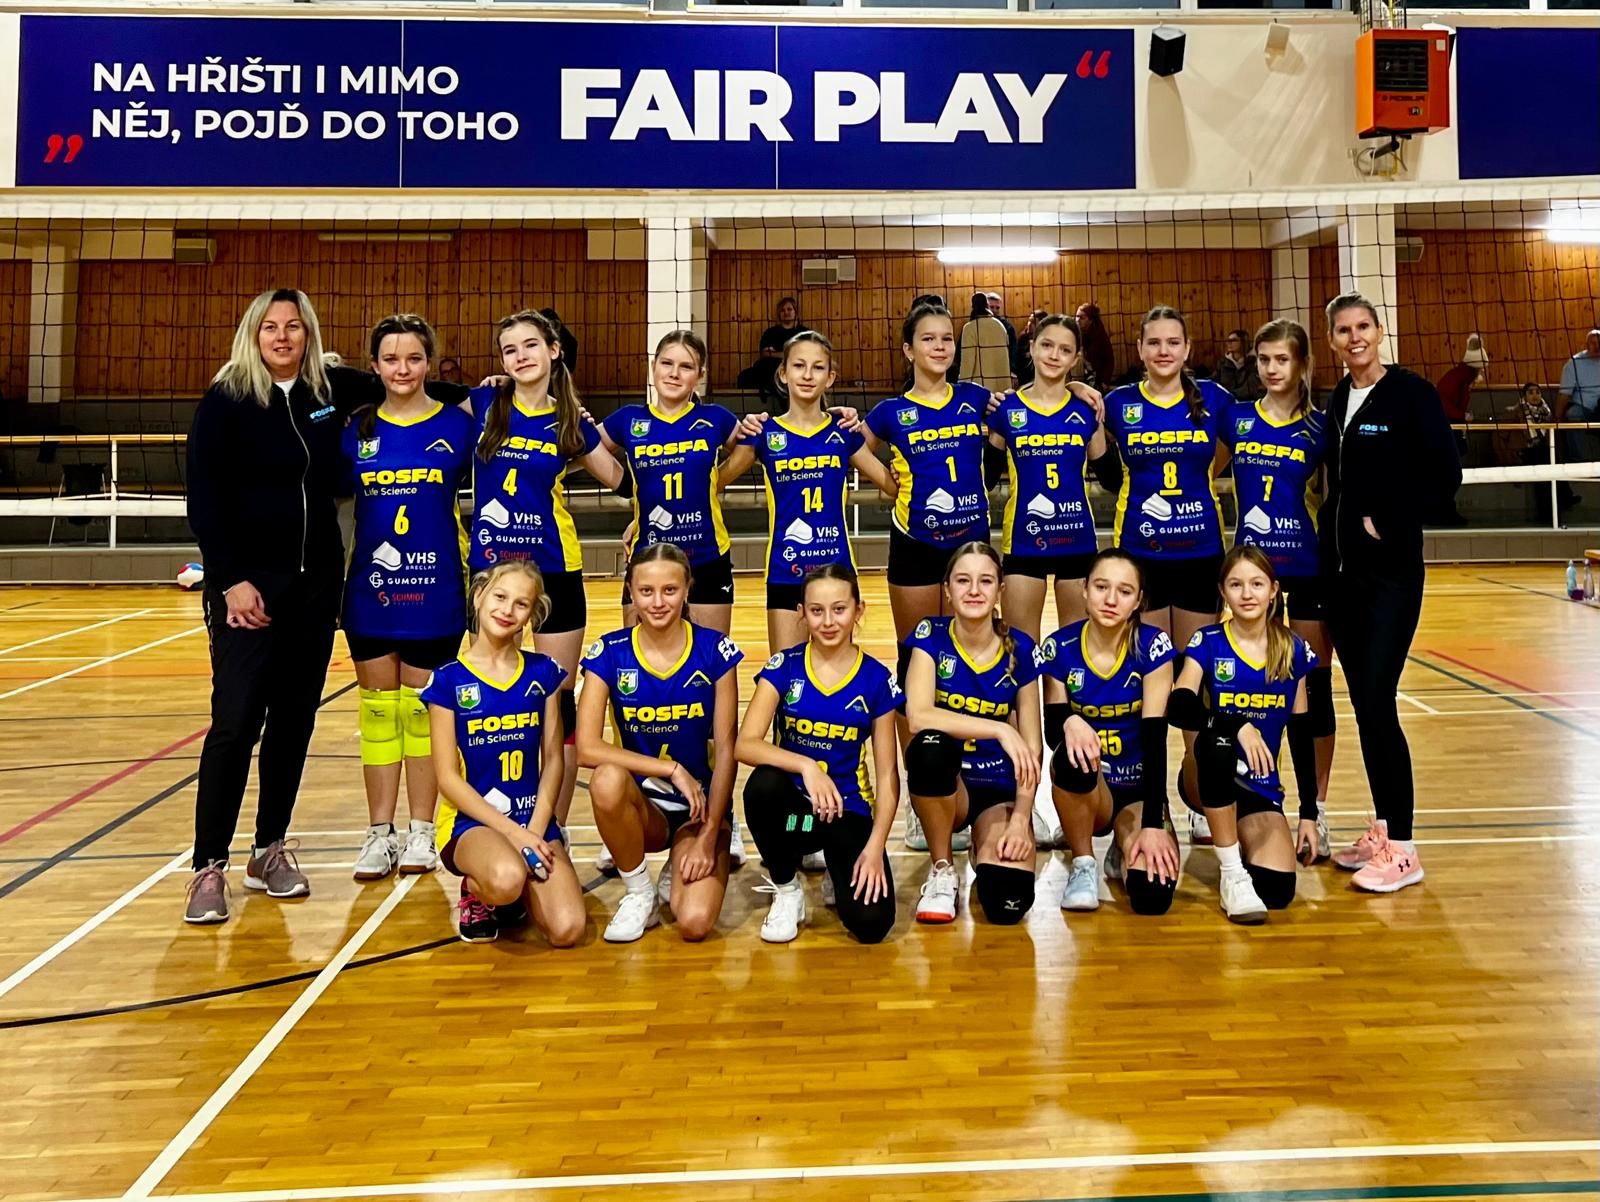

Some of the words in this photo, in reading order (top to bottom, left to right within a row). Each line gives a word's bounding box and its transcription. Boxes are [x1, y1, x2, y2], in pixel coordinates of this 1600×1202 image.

[92, 62, 155, 93] NA
[167, 56, 301, 94] HŘIŠTI
[316, 64, 325, 94] I
[340, 64, 460, 95] MIMO
[560, 67, 794, 142] FAIR
[813, 71, 1069, 144] PLAY
[91, 101, 181, 145] NĚJ,
[194, 102, 307, 141] POJĎ
[322, 110, 386, 141] DO
[397, 110, 520, 141] TOHO
[908, 423, 980, 446] FOSFA
[1015, 434, 1084, 449] FOSFA
[1127, 430, 1210, 447] FOSFA
[496, 449, 530, 461] cience
[634, 439, 709, 459] FOSFA
[910, 445, 925, 455] Life
[927, 441, 959, 452] Science
[1016, 449, 1030, 458] Life
[1031, 448, 1063, 457] Science
[1128, 447, 1143, 456] Life
[1145, 446, 1184, 455] Science
[1235, 441, 1306, 464] FOSFA
[635, 458, 647, 469] Life
[649, 456, 685, 467] Science
[774, 455, 841, 473] FOSFA
[945, 456, 957, 482] 1
[1247, 456, 1281, 468] Science
[361, 468, 443, 487] FOSFA
[502, 468, 518, 497] 4
[776, 473, 790, 482] Life
[792, 471, 823, 481] Science
[1045, 463, 1059, 490] 5
[1163, 461, 1177, 490] 8
[364, 488, 378, 497] Life
[380, 486, 417, 496] Science
[662, 472, 683, 501] 11
[1262, 474, 1274, 502] 7
[801, 486, 823, 513] 14
[957, 494, 978, 506] VHS
[1058, 501, 1082, 513] VHS
[1176, 501, 1204, 514] VHS
[394, 505, 409, 535] 6
[514, 512, 542, 525] VHS
[677, 511, 702, 524] VHS
[943, 515, 981, 527] GUMOTEX
[1275, 517, 1301, 530] VHS
[816, 526, 840, 538] VHS
[1044, 523, 1084, 532] GUMOTEX
[1159, 524, 1206, 535] GUMOTEX
[496, 534, 543, 545] GUMOTEX
[661, 533, 703, 542] GUMOTEX
[1259, 540, 1302, 548] GUMOTEX
[406, 552, 436, 564] VHS
[800, 548, 840, 558] GUMOTEX
[387, 577, 436, 586] GUMOTEX
[935, 688, 1010, 717] FOSFA
[1219, 691, 1287, 709] FOSFA
[623, 702, 705, 722] FOSFA
[1070, 699, 1143, 719] FOSFA
[467, 711, 540, 735] FOSFA
[640, 722, 679, 733] Science
[784, 715, 859, 742] FOSFA
[468, 734, 485, 747] Life
[487, 732, 525, 745] Science
[797, 736, 833, 751] Science
[1097, 729, 1122, 757] 15
[499, 750, 523, 782] 10
[1116, 763, 1144, 776] VHS
[515, 795, 537, 810] VHS
